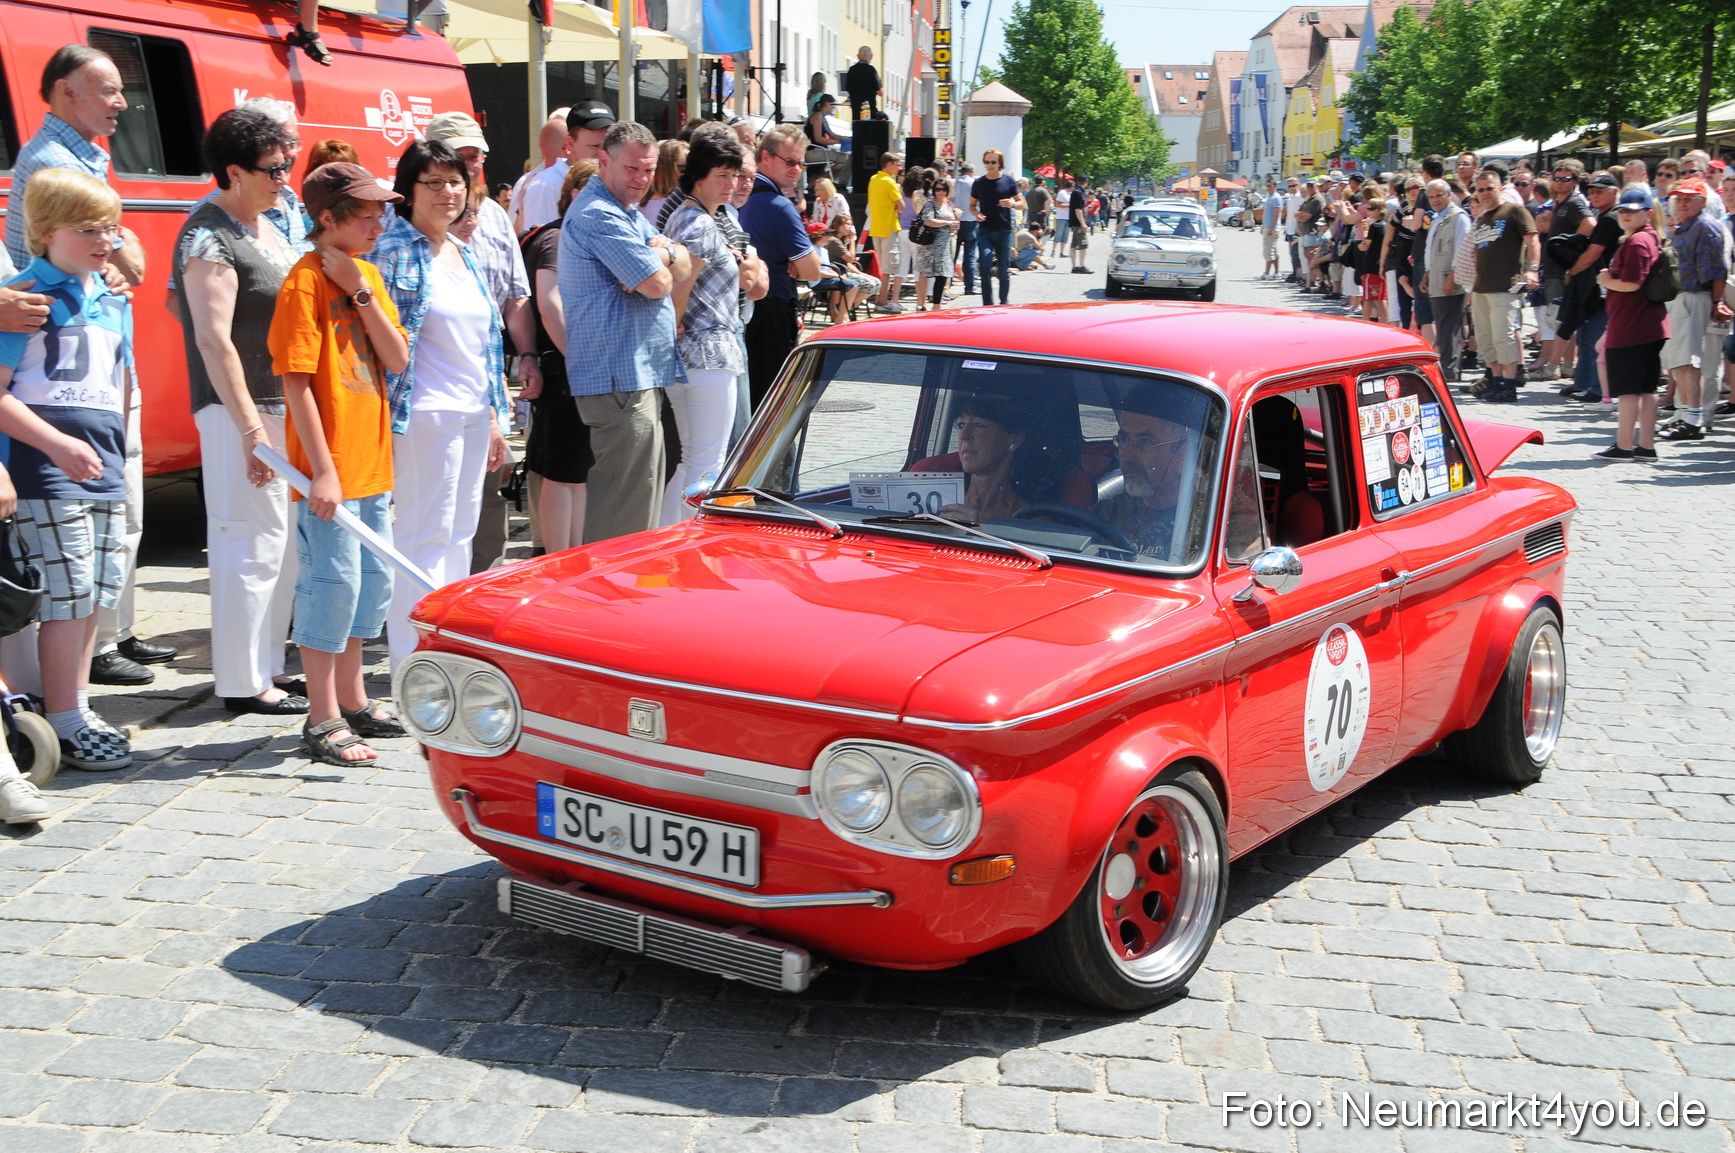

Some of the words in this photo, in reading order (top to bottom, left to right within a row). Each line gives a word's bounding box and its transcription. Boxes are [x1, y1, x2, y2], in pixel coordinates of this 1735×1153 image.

[934, 31, 951, 118] HOTEL
[411, 104, 433, 115] BOSCH
[1413, 440, 1421, 455] 62
[906, 490, 943, 516] 30
[1325, 679, 1352, 746] 70
[564, 797, 604, 843] SC
[630, 812, 652, 857] U
[663, 820, 708, 867] 59
[723, 832, 746, 877] H
